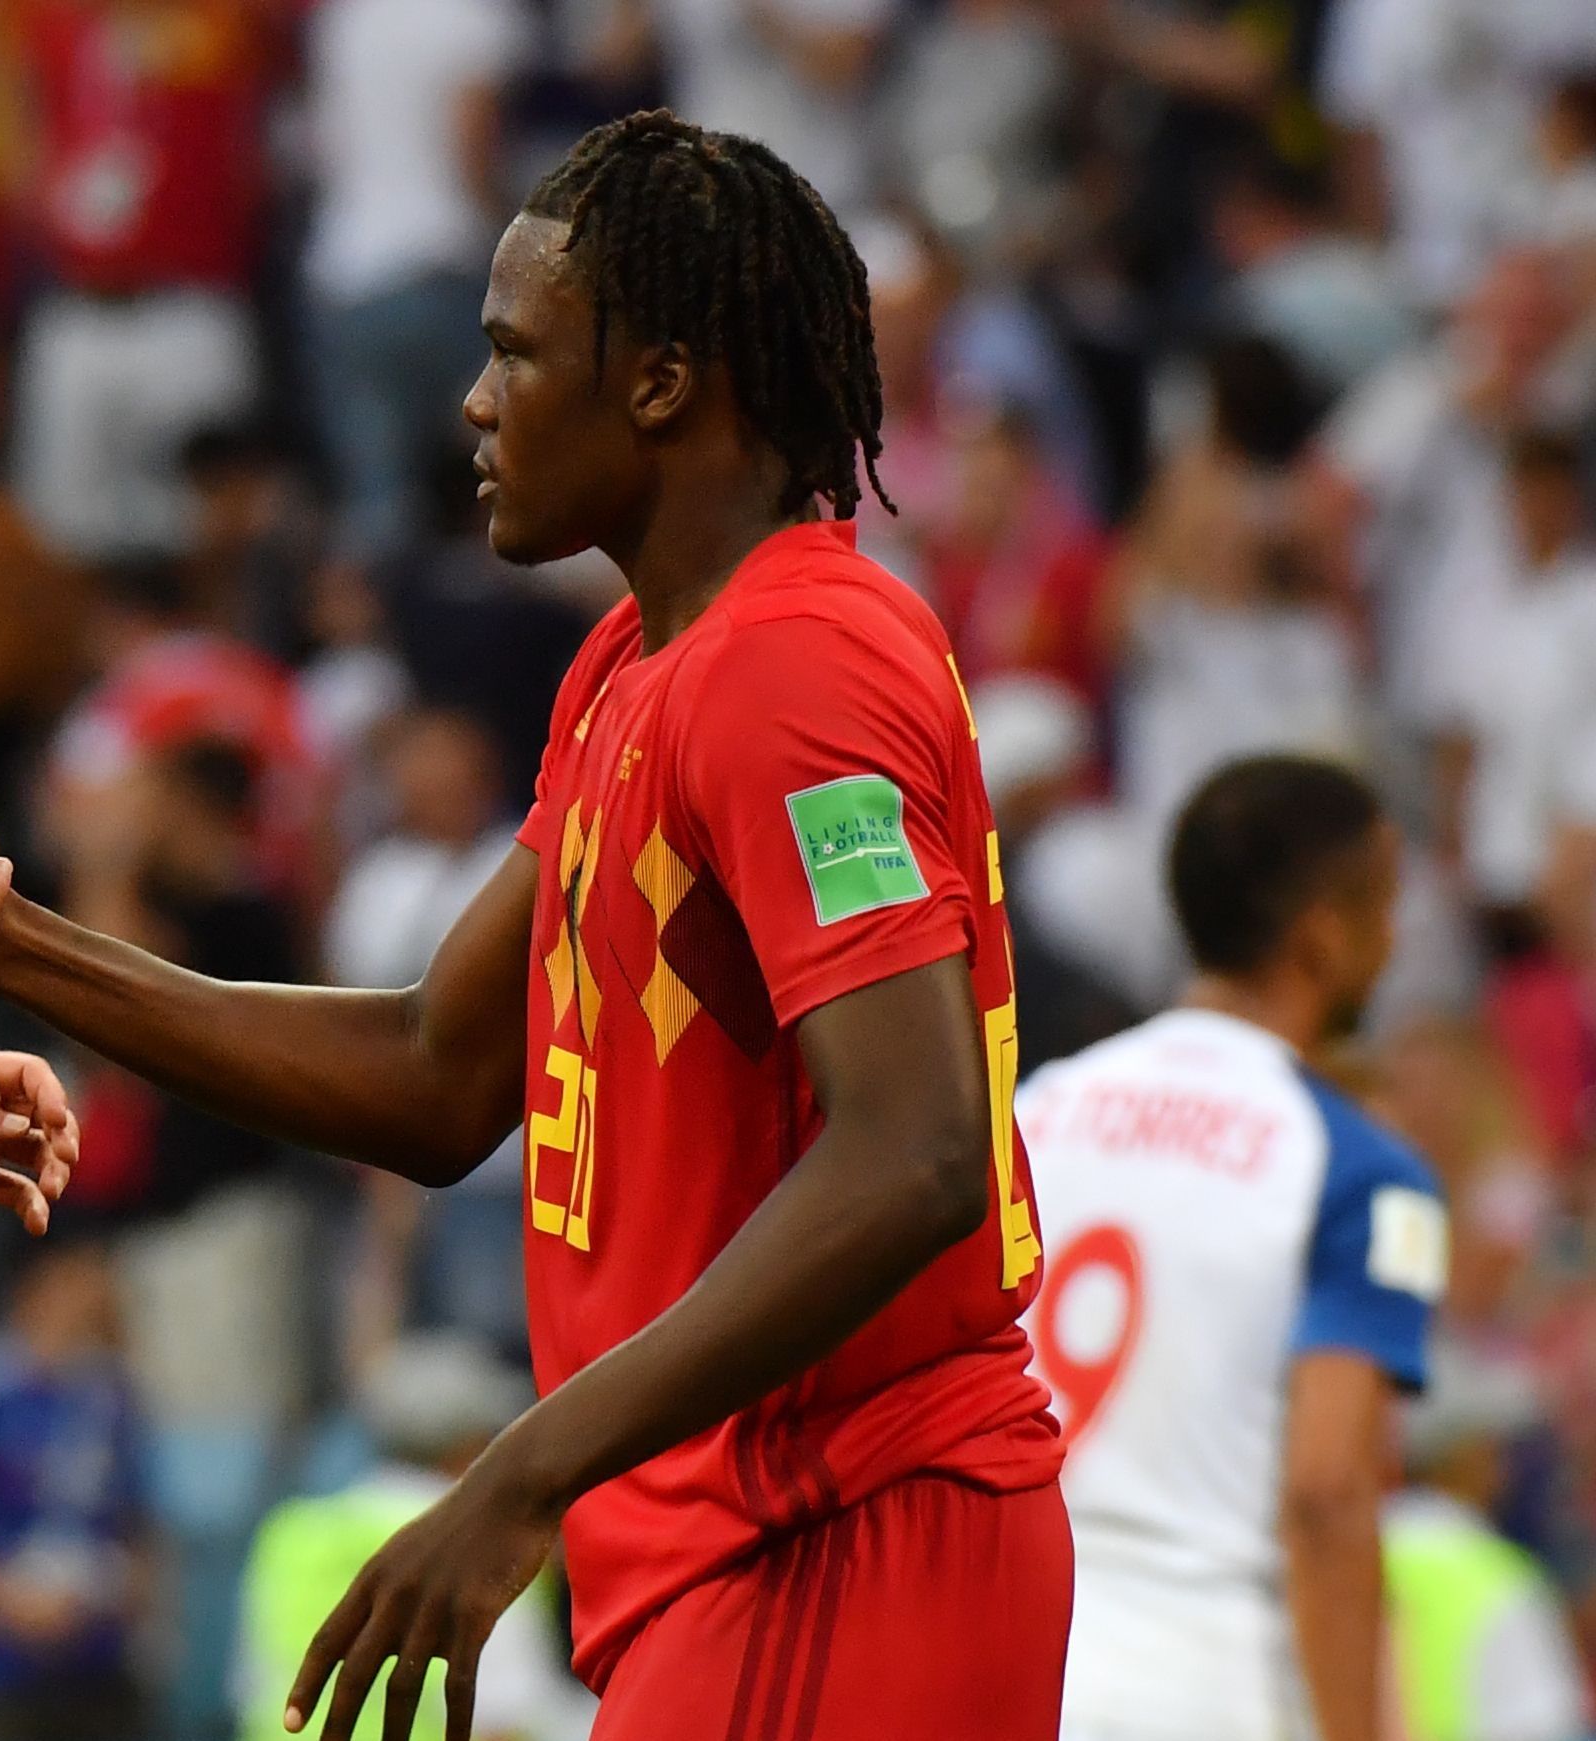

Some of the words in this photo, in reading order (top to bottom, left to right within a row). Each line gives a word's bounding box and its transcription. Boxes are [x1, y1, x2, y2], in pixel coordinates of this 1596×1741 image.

[807, 816, 893, 844] LIVING
[874, 856, 906, 869] FIFA
[529, 1043, 597, 1252] 20
[1034, 1218, 1144, 1450] 9
